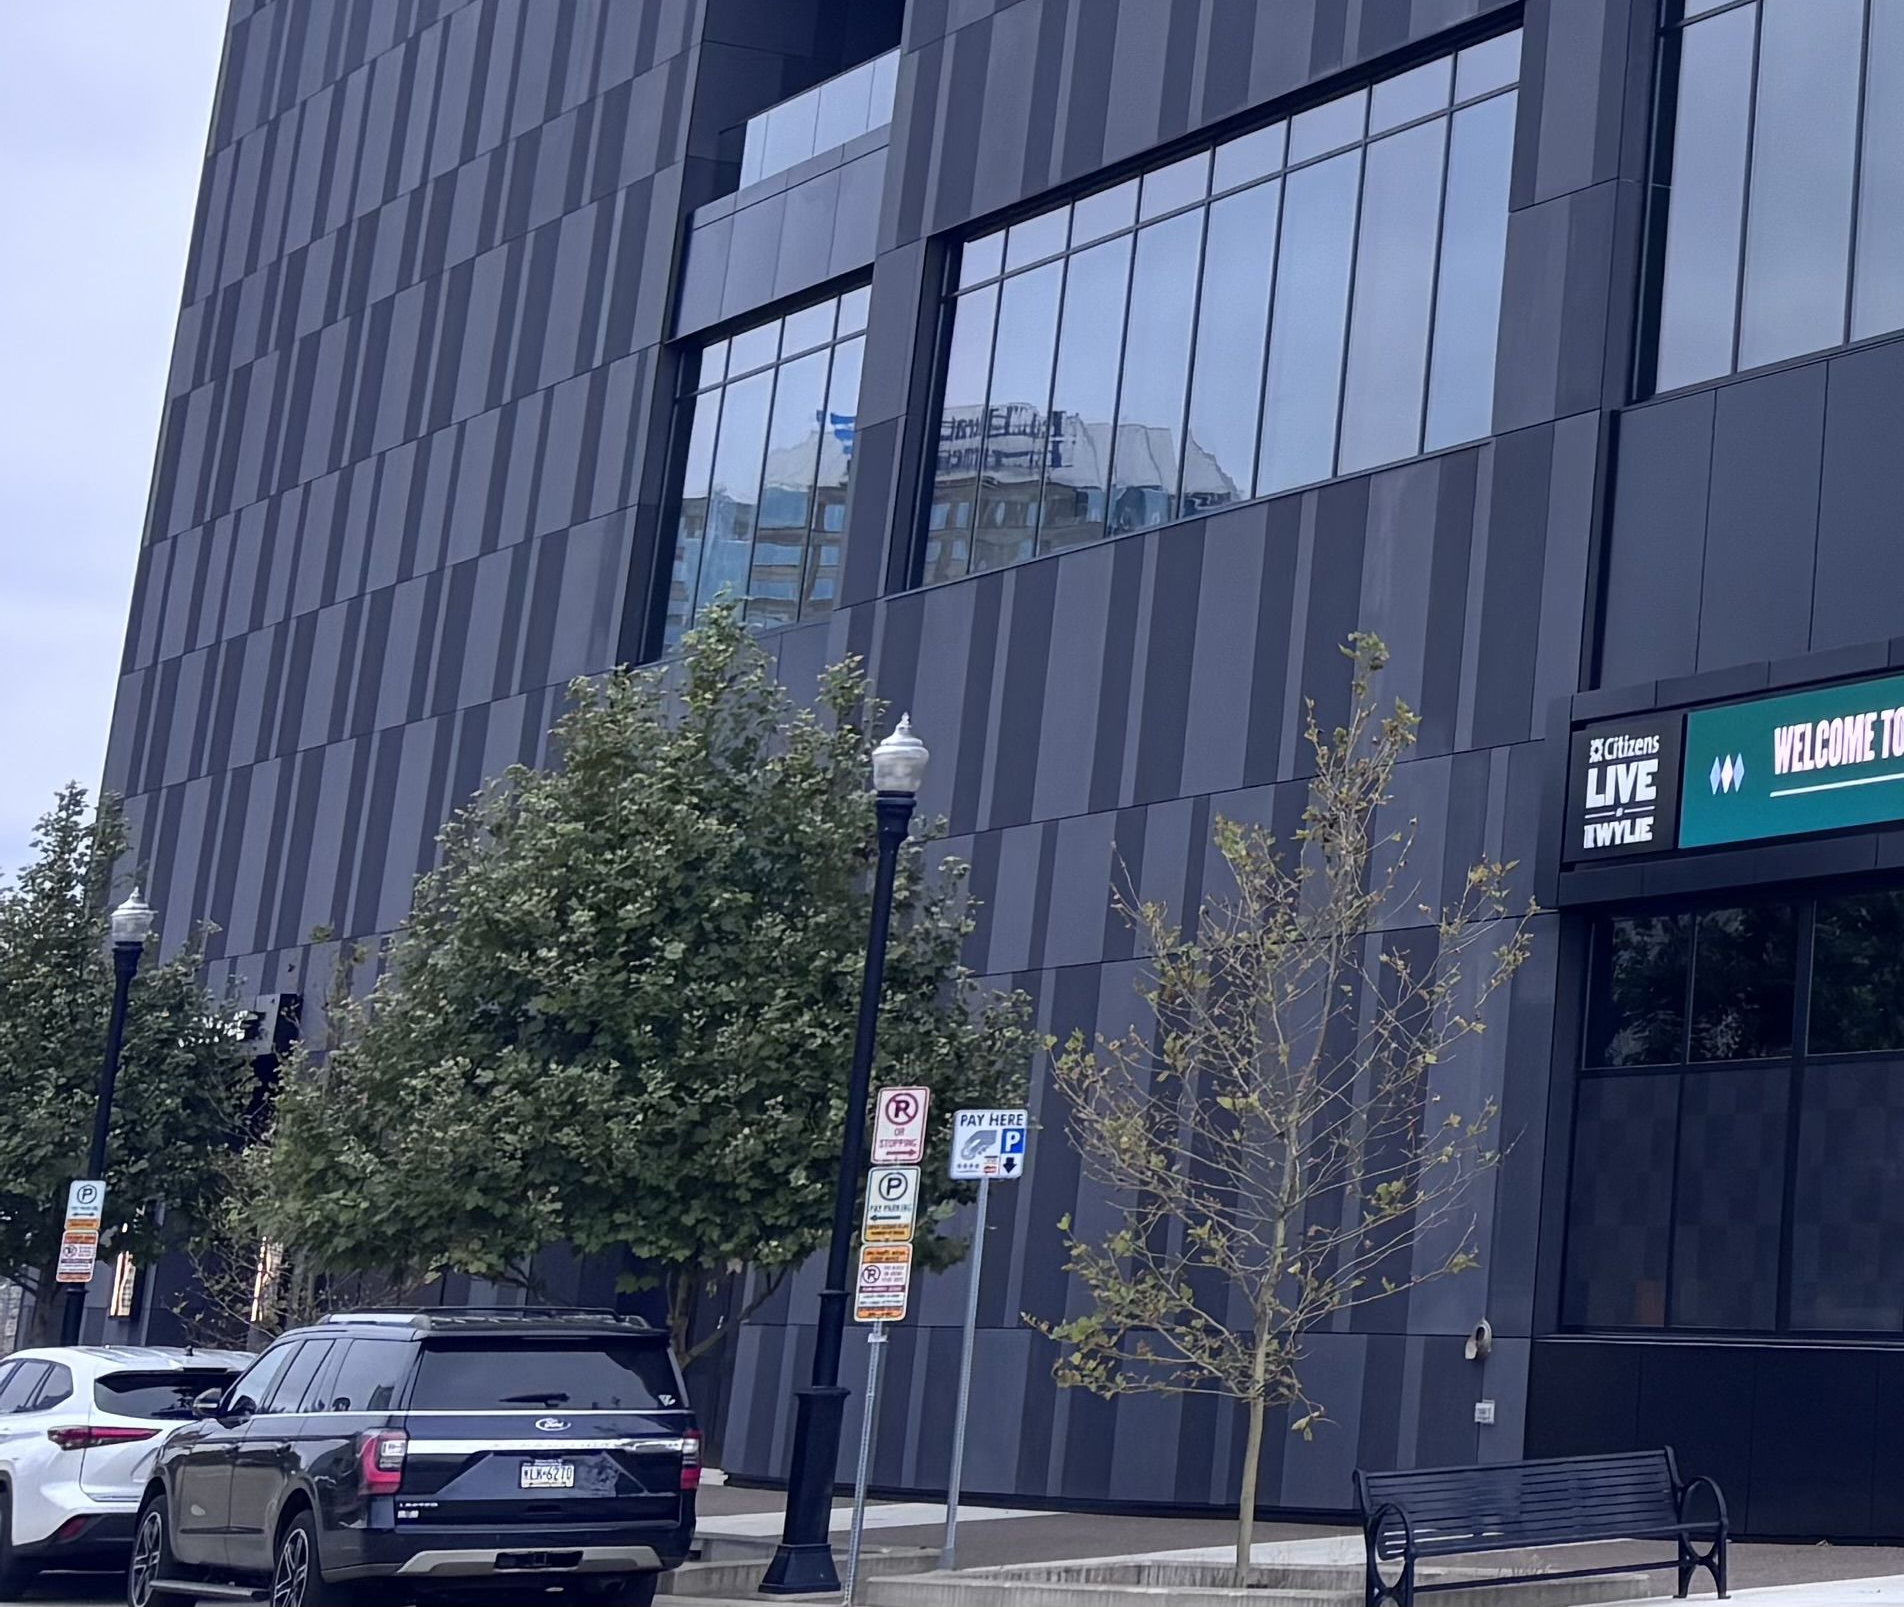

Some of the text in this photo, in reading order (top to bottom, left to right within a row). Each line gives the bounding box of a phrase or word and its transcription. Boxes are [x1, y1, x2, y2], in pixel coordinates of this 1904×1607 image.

[1605, 735, 1660, 760] Citizens
[1774, 712, 1878, 775] WELCOME
[1586, 758, 1658, 808] LIVE
[1595, 816, 1654, 847] WYLIE
[961, 1114, 1024, 1126] PAY HERE
